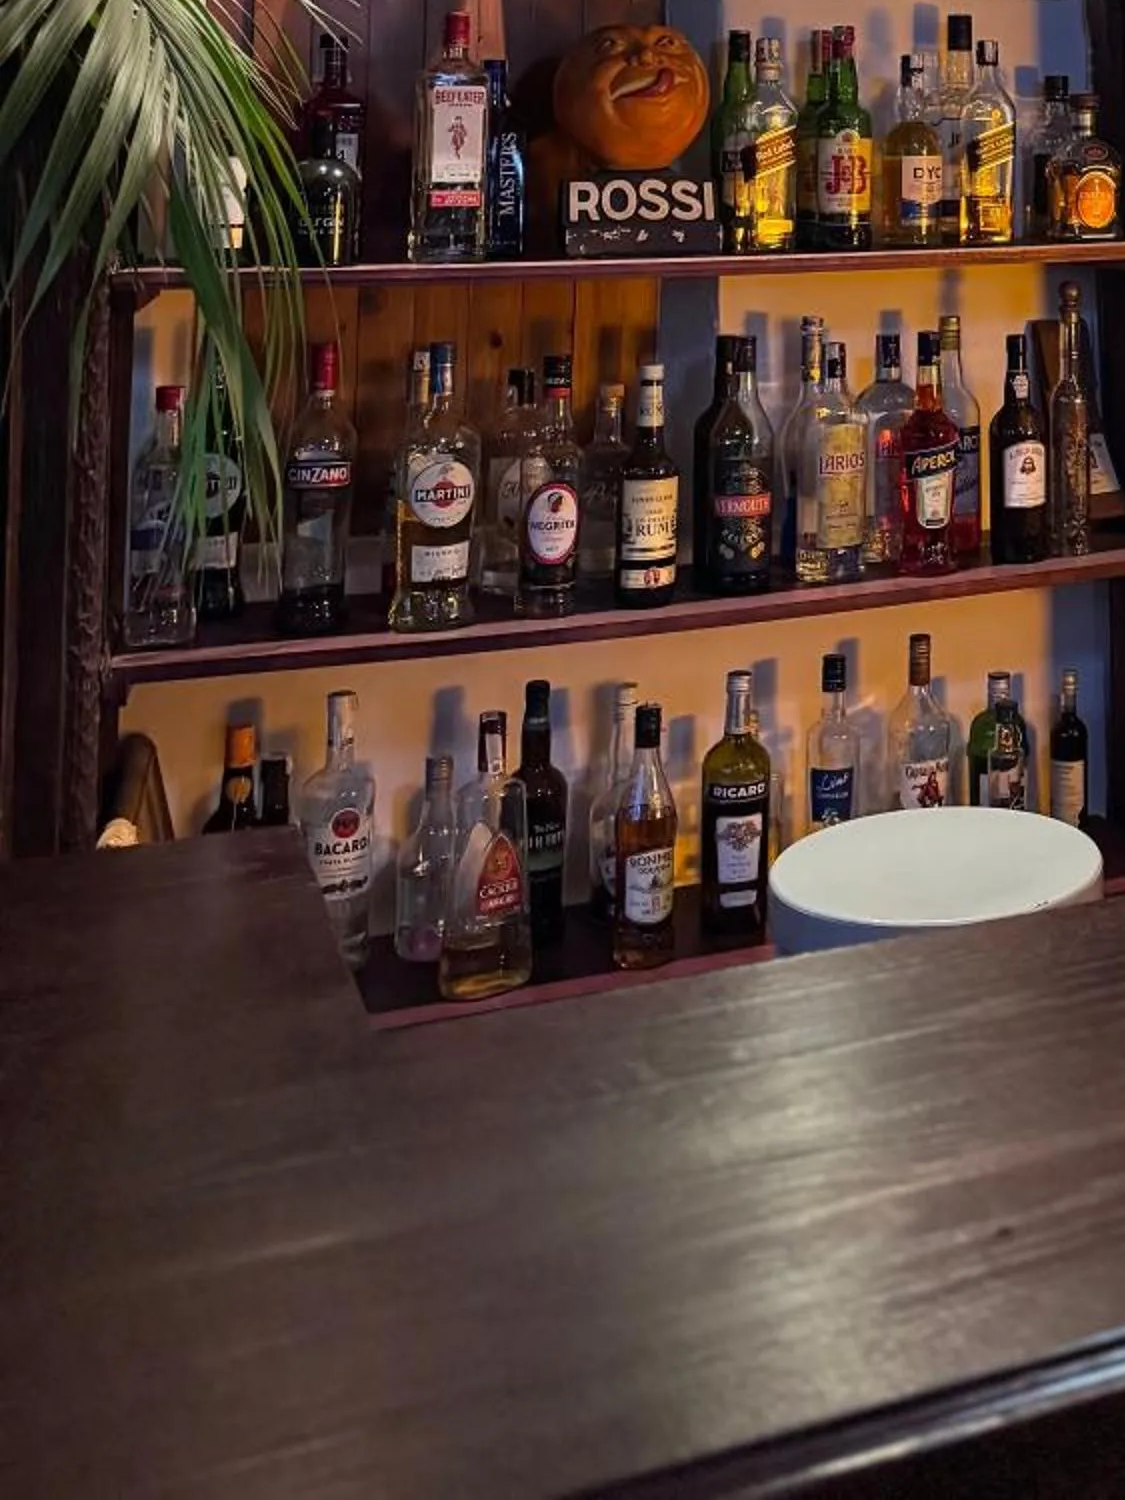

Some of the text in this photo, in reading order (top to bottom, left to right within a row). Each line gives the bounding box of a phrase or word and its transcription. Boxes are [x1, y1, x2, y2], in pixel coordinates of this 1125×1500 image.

[435, 89, 485, 104] BEEFEATER
[569, 179, 716, 222] ROSSI
[819, 451, 866, 474] LARIOS
[288, 467, 348, 484] CINZANO
[416, 484, 472, 502] MARTINI
[713, 783, 766, 799] RICARD
